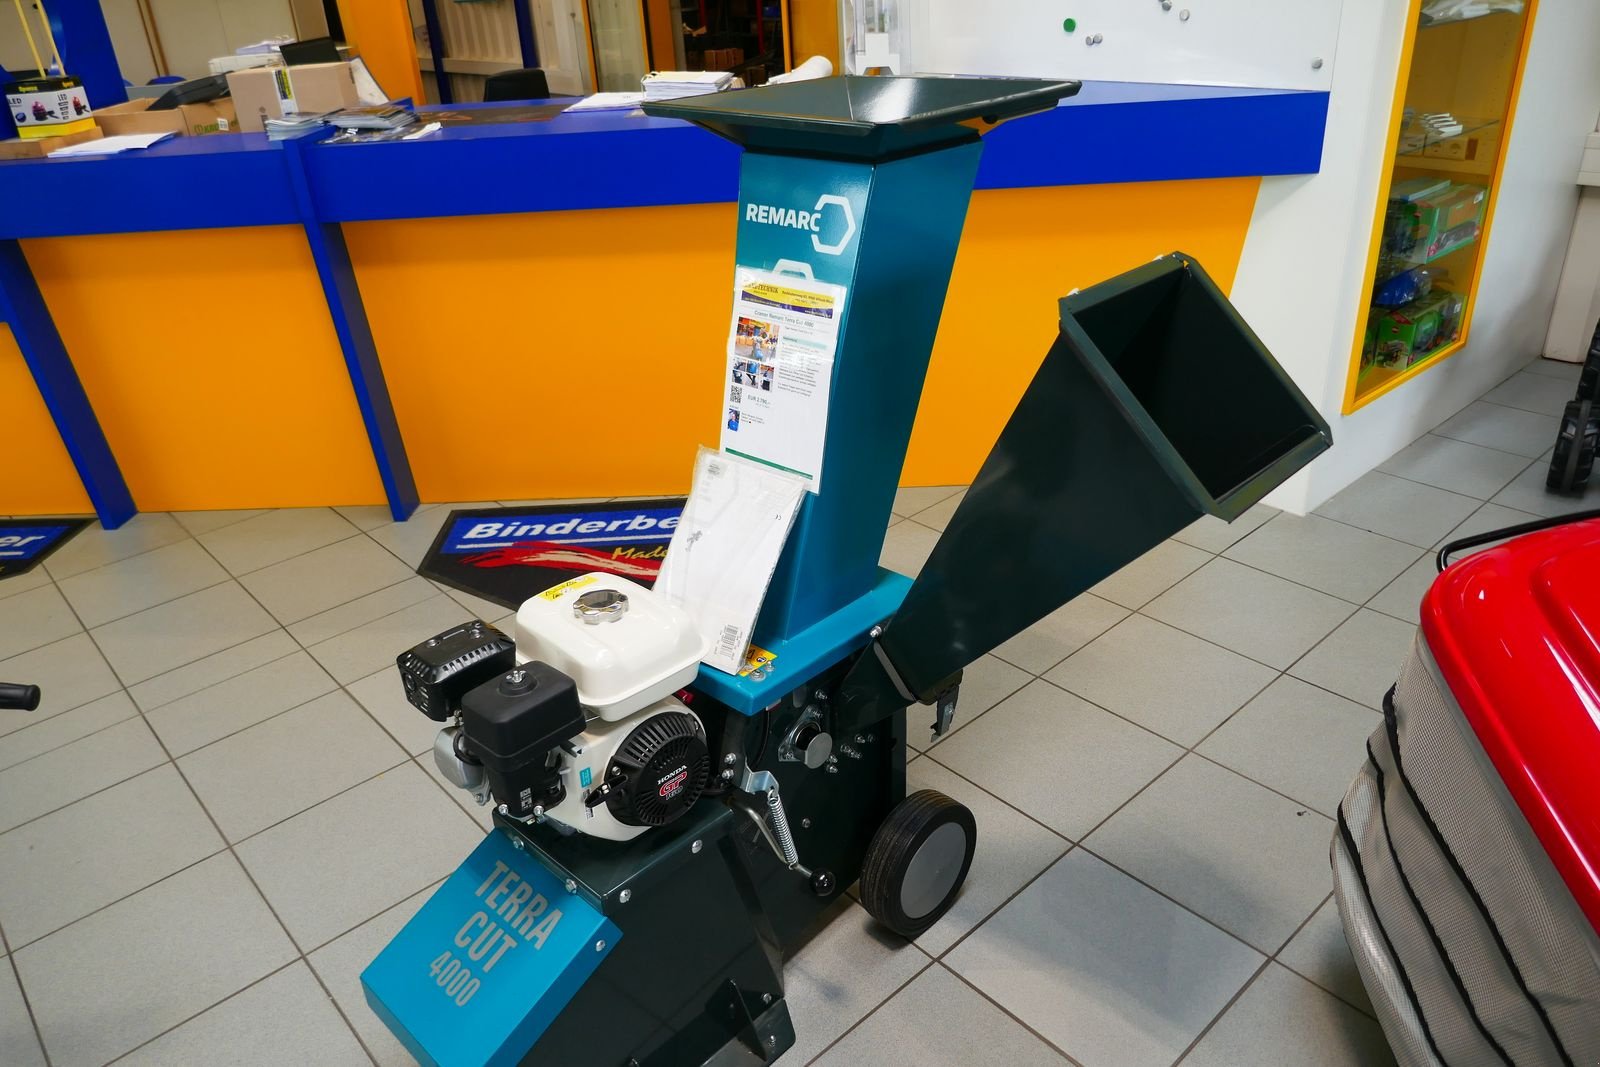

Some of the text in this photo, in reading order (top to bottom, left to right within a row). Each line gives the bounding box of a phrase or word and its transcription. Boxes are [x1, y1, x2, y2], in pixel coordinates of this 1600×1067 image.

[8, 97, 22, 105] LED
[58, 93, 68, 102] LED
[746, 203, 821, 233] REMARC
[657, 765, 687, 785] HONDA
[474, 860, 564, 950] TERRA
[454, 911, 518, 973] CUT
[429, 950, 481, 1007] 4000
